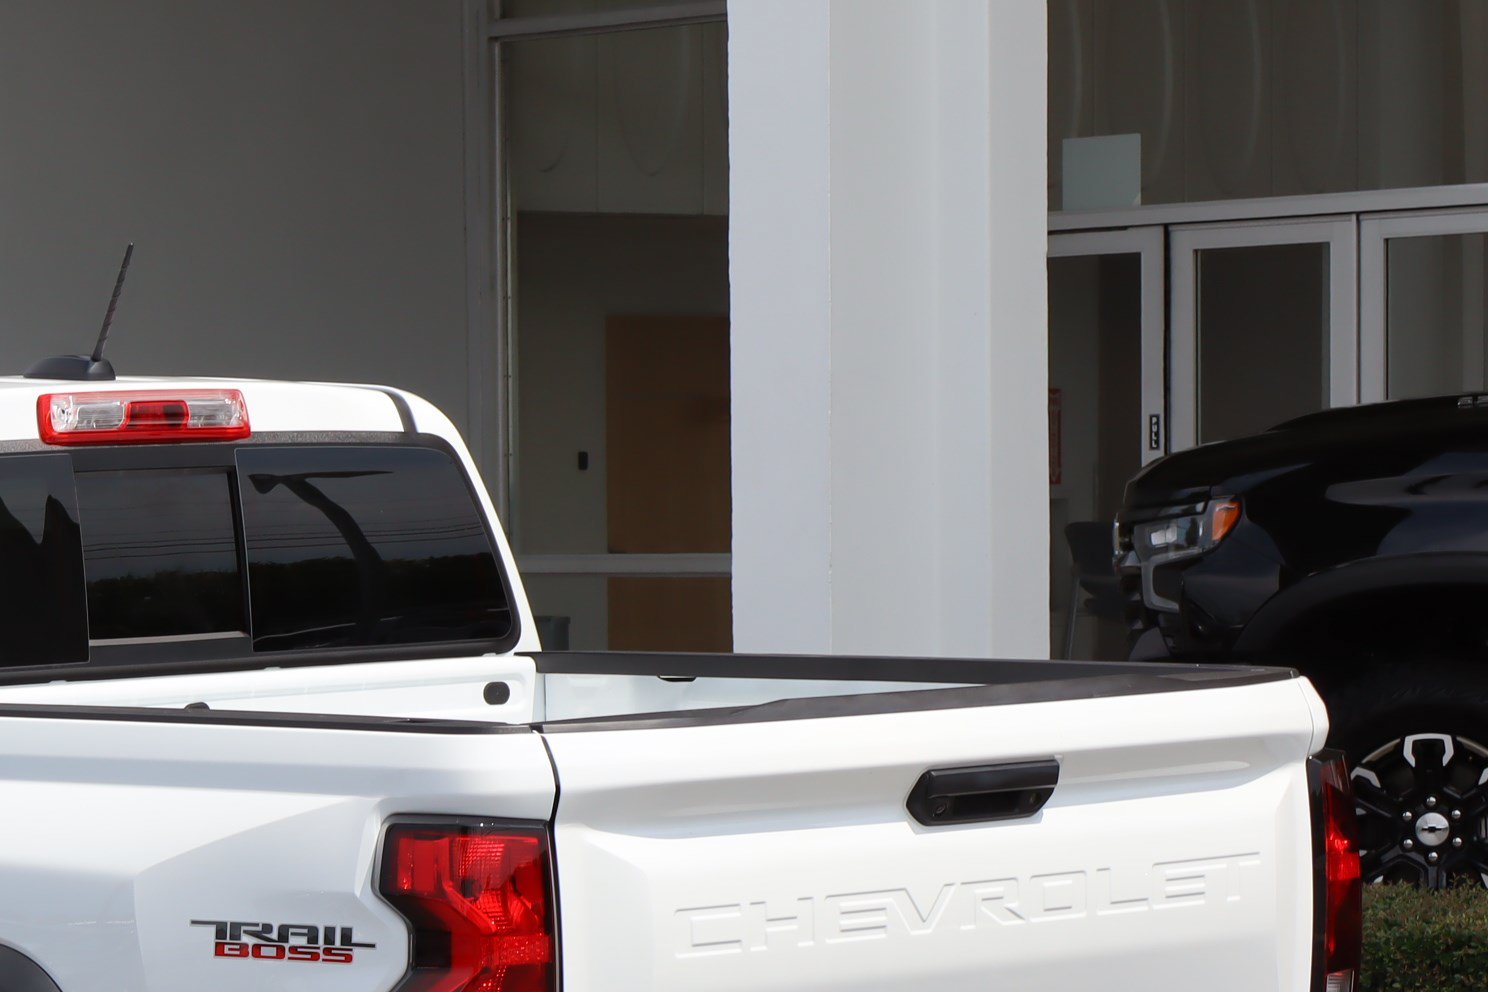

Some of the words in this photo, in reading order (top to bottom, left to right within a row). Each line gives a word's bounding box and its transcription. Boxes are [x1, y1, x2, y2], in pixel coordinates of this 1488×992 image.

[673, 851, 1261, 959] CHEVROLET
[190, 919, 377, 949] TRAIL
[214, 941, 354, 964] BOSS
